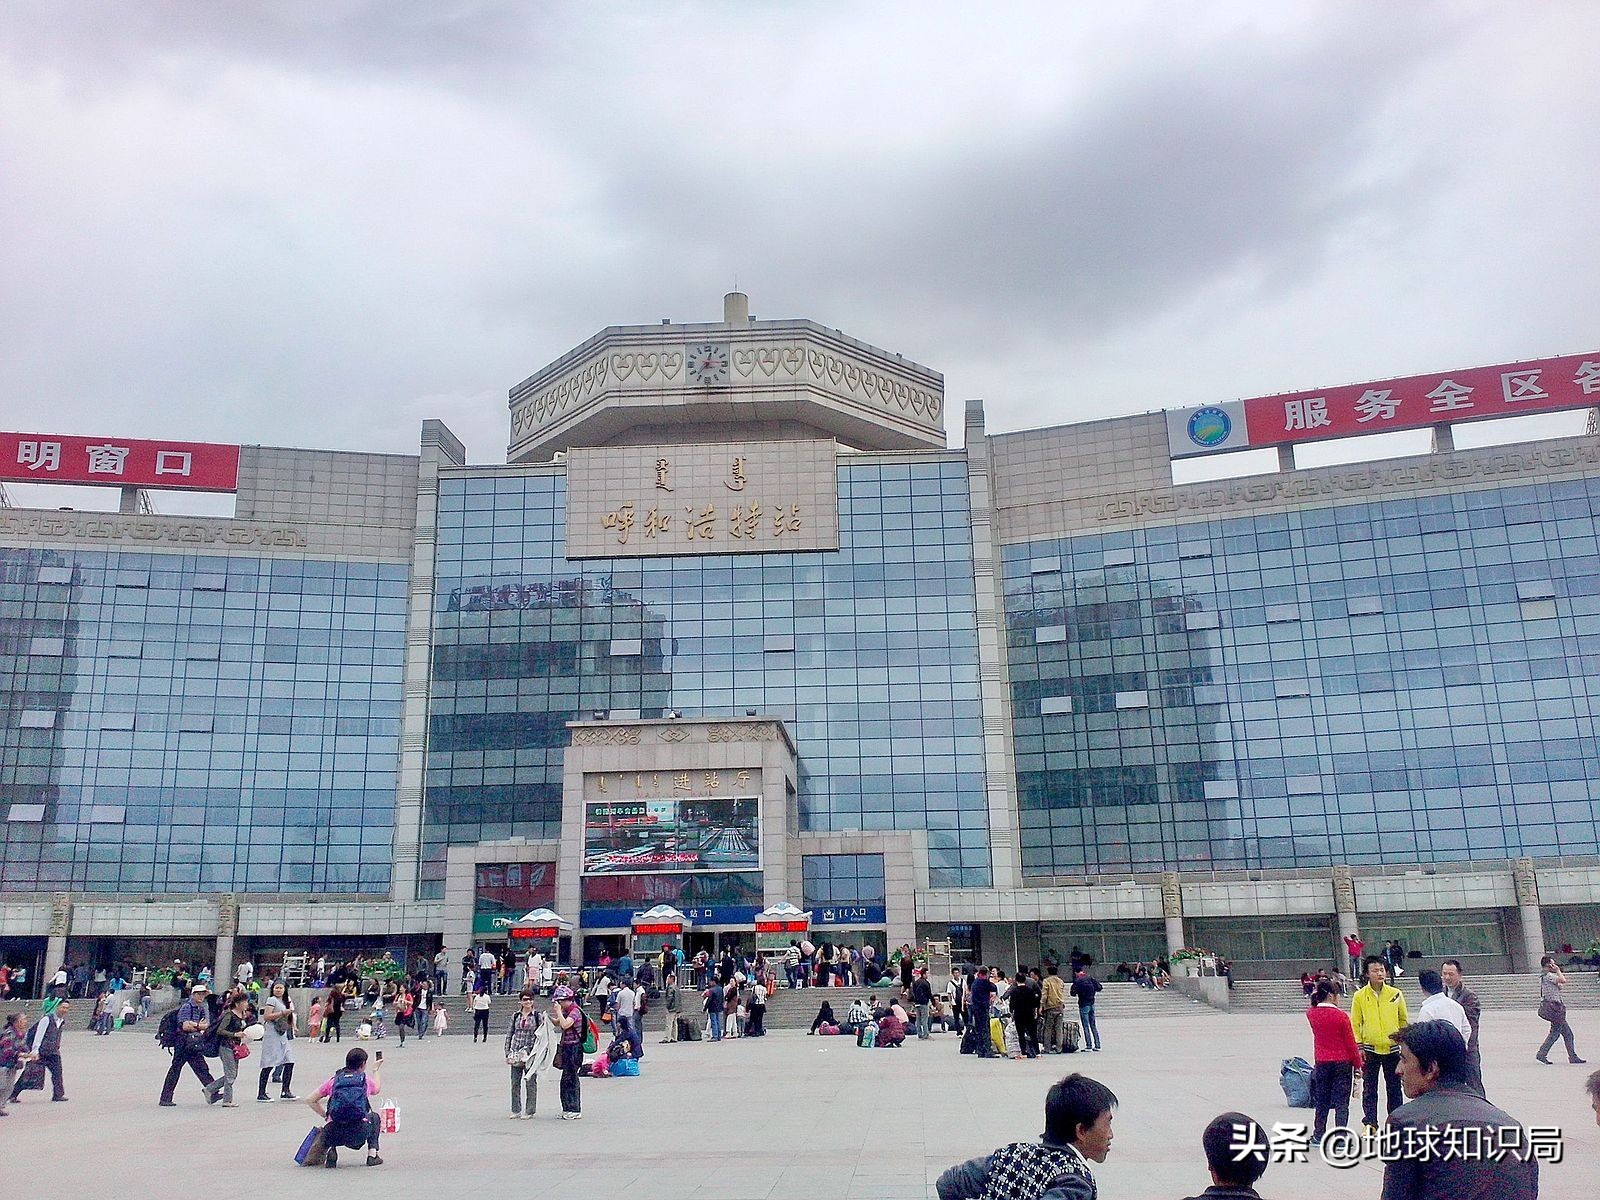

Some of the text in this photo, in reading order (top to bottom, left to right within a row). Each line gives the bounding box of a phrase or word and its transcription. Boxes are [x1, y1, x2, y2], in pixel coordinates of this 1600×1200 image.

[17, 440, 192, 476] 明窗口
[601, 501, 802, 544] 呼和浩特站
[674, 771, 751, 790] 进站厅
[850, 908, 867, 917] 入口
